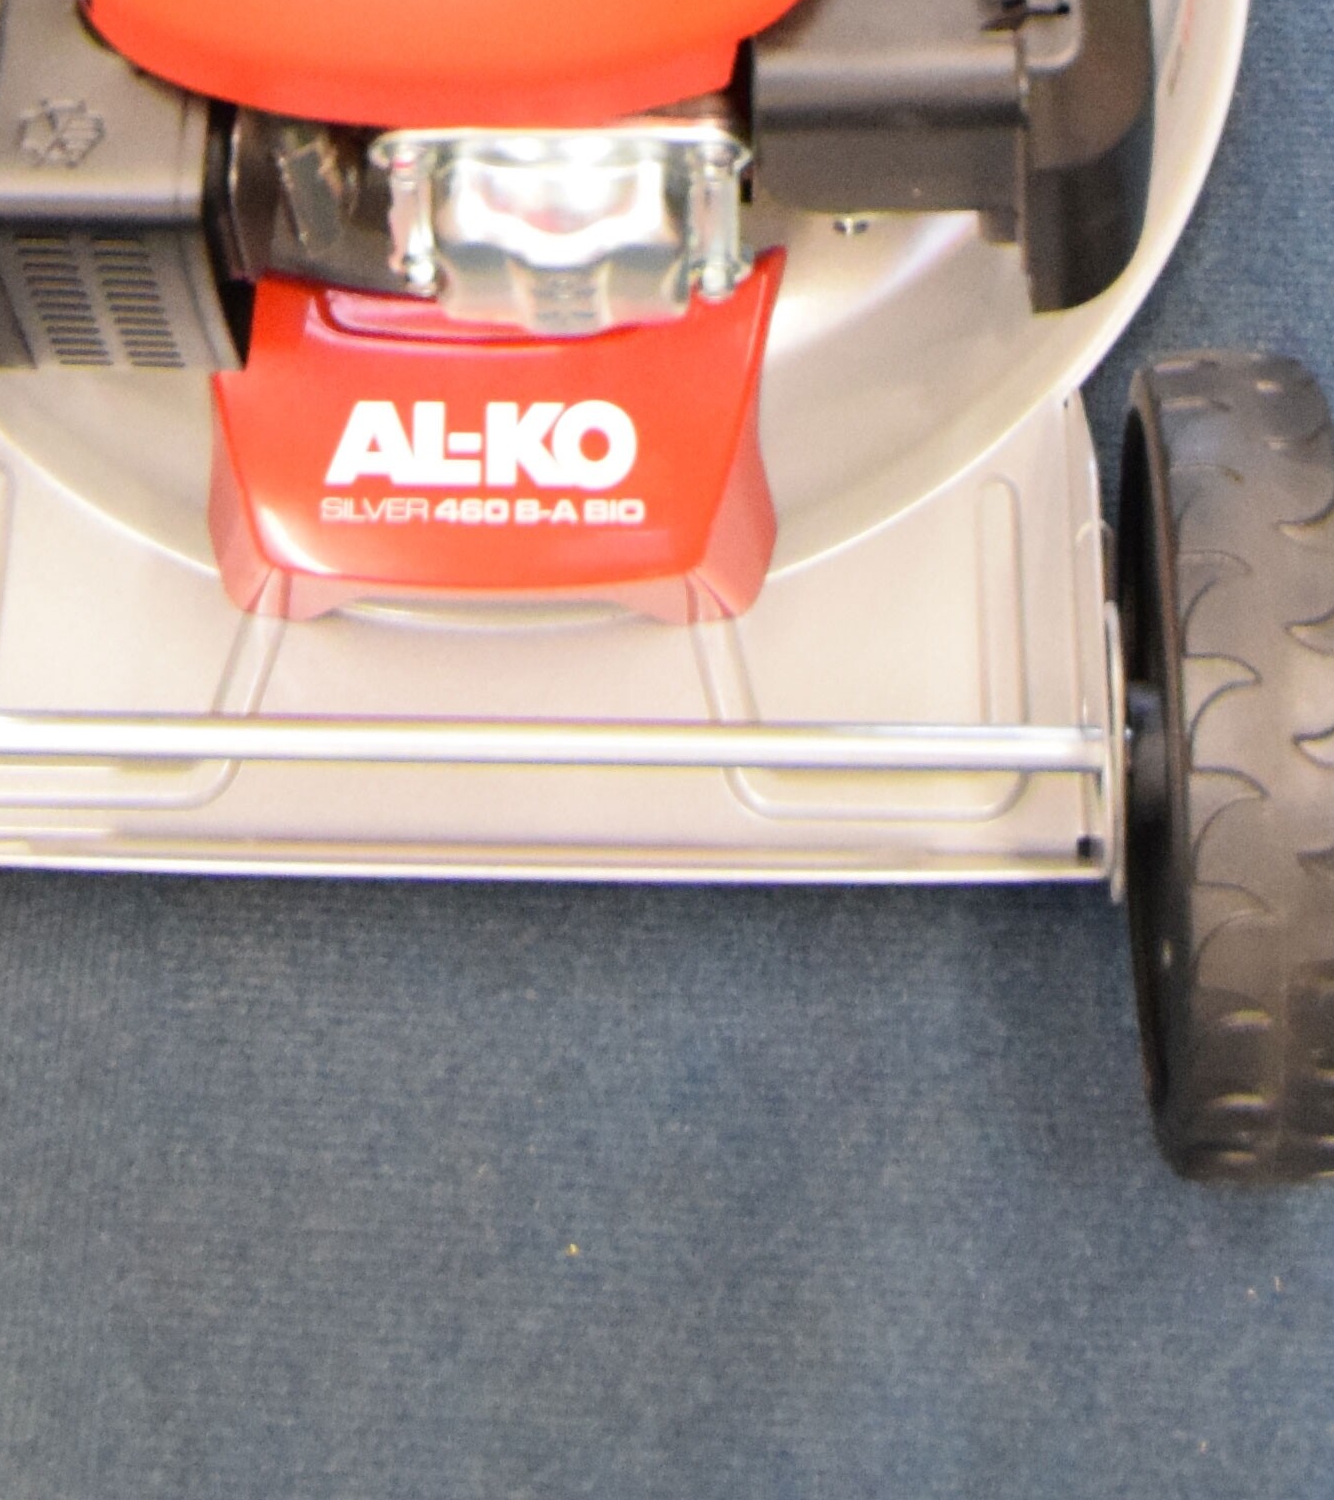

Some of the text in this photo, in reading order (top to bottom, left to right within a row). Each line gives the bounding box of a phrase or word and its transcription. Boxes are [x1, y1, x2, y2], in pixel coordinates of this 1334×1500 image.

[324, 399, 638, 491] AL-KO
[320, 496, 429, 524] SILVER
[514, 497, 579, 525] B-A
[583, 497, 645, 525] BIO
